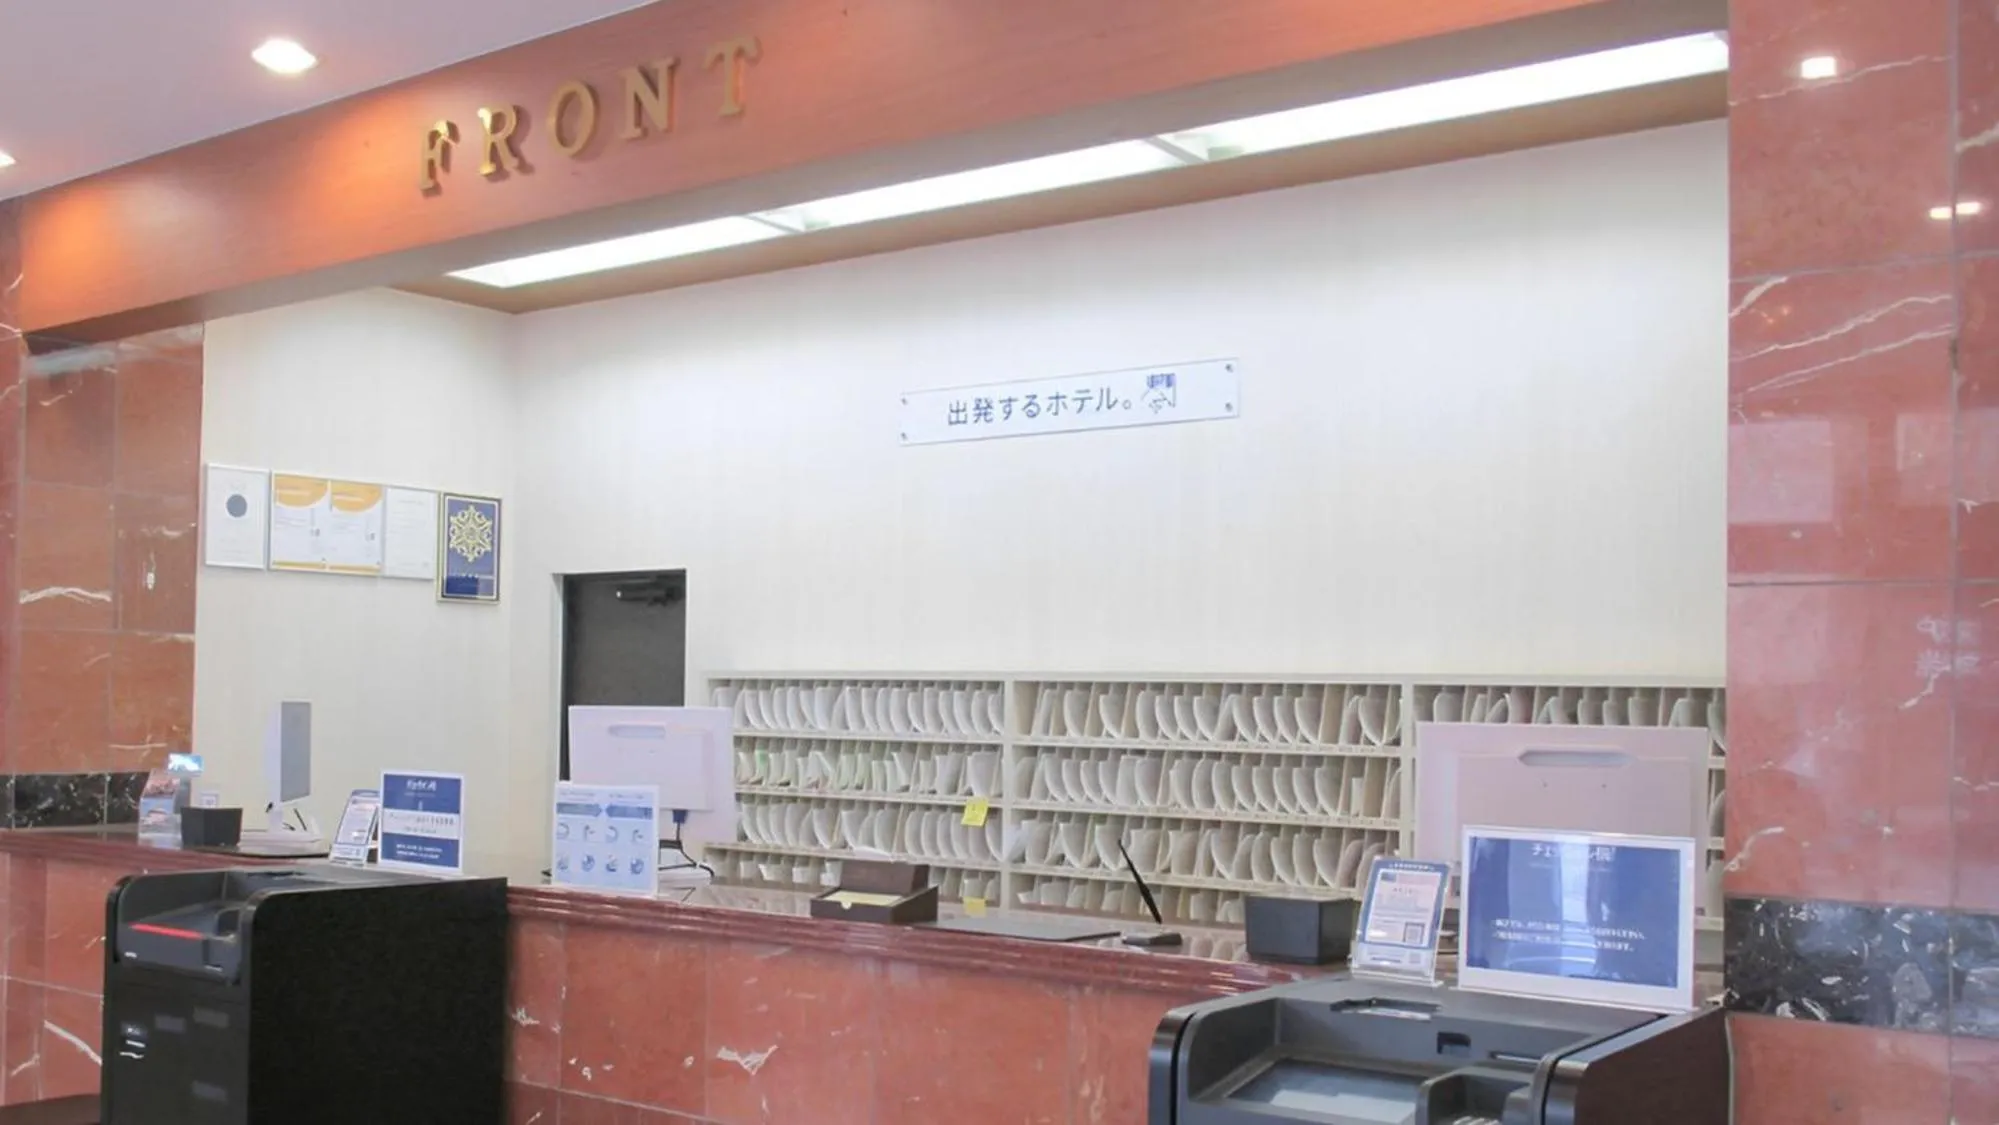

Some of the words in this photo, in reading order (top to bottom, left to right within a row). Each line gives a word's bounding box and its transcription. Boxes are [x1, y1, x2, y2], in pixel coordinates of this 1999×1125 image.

[419, 36, 759, 194] FRONT
[947, 387, 1132, 426] 出発するホテル。
